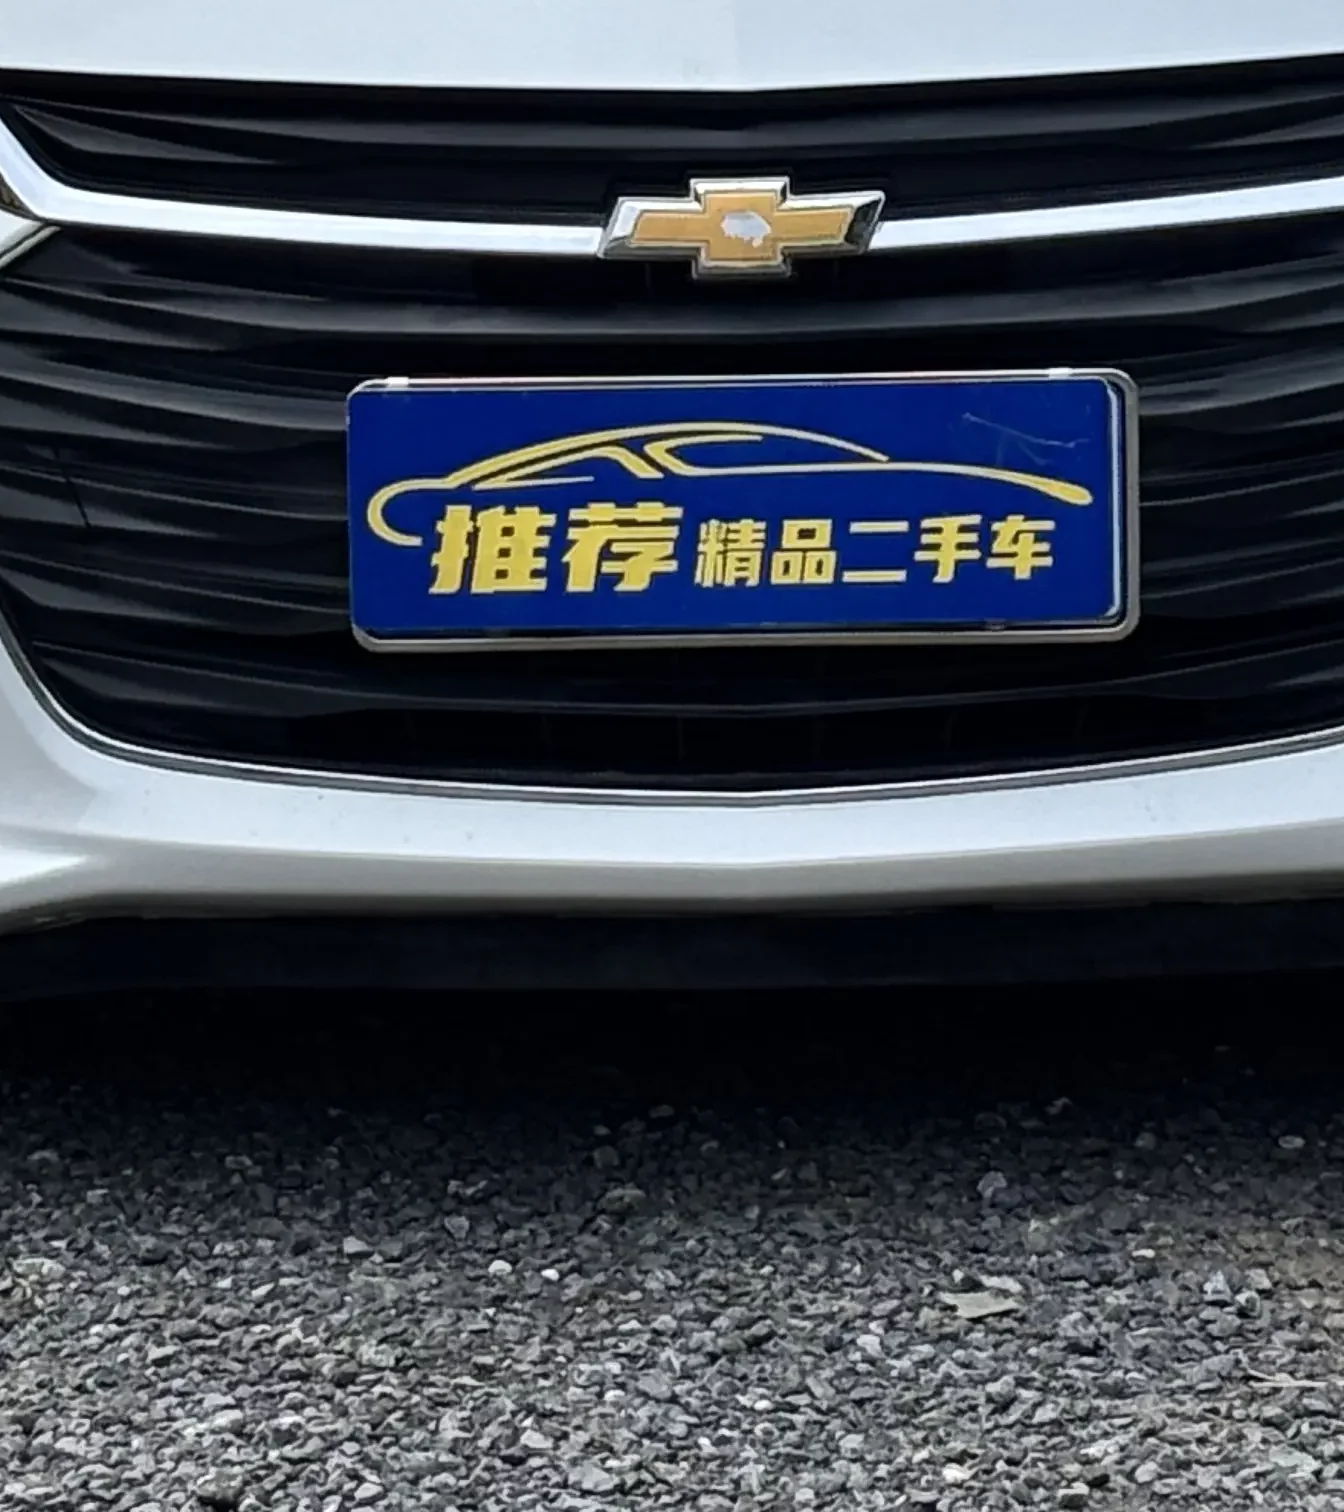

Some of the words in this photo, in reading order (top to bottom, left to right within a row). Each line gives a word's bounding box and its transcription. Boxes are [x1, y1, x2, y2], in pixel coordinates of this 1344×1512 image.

[428, 502, 684, 594] 推荐
[695, 513, 1057, 588] 精品二手车
